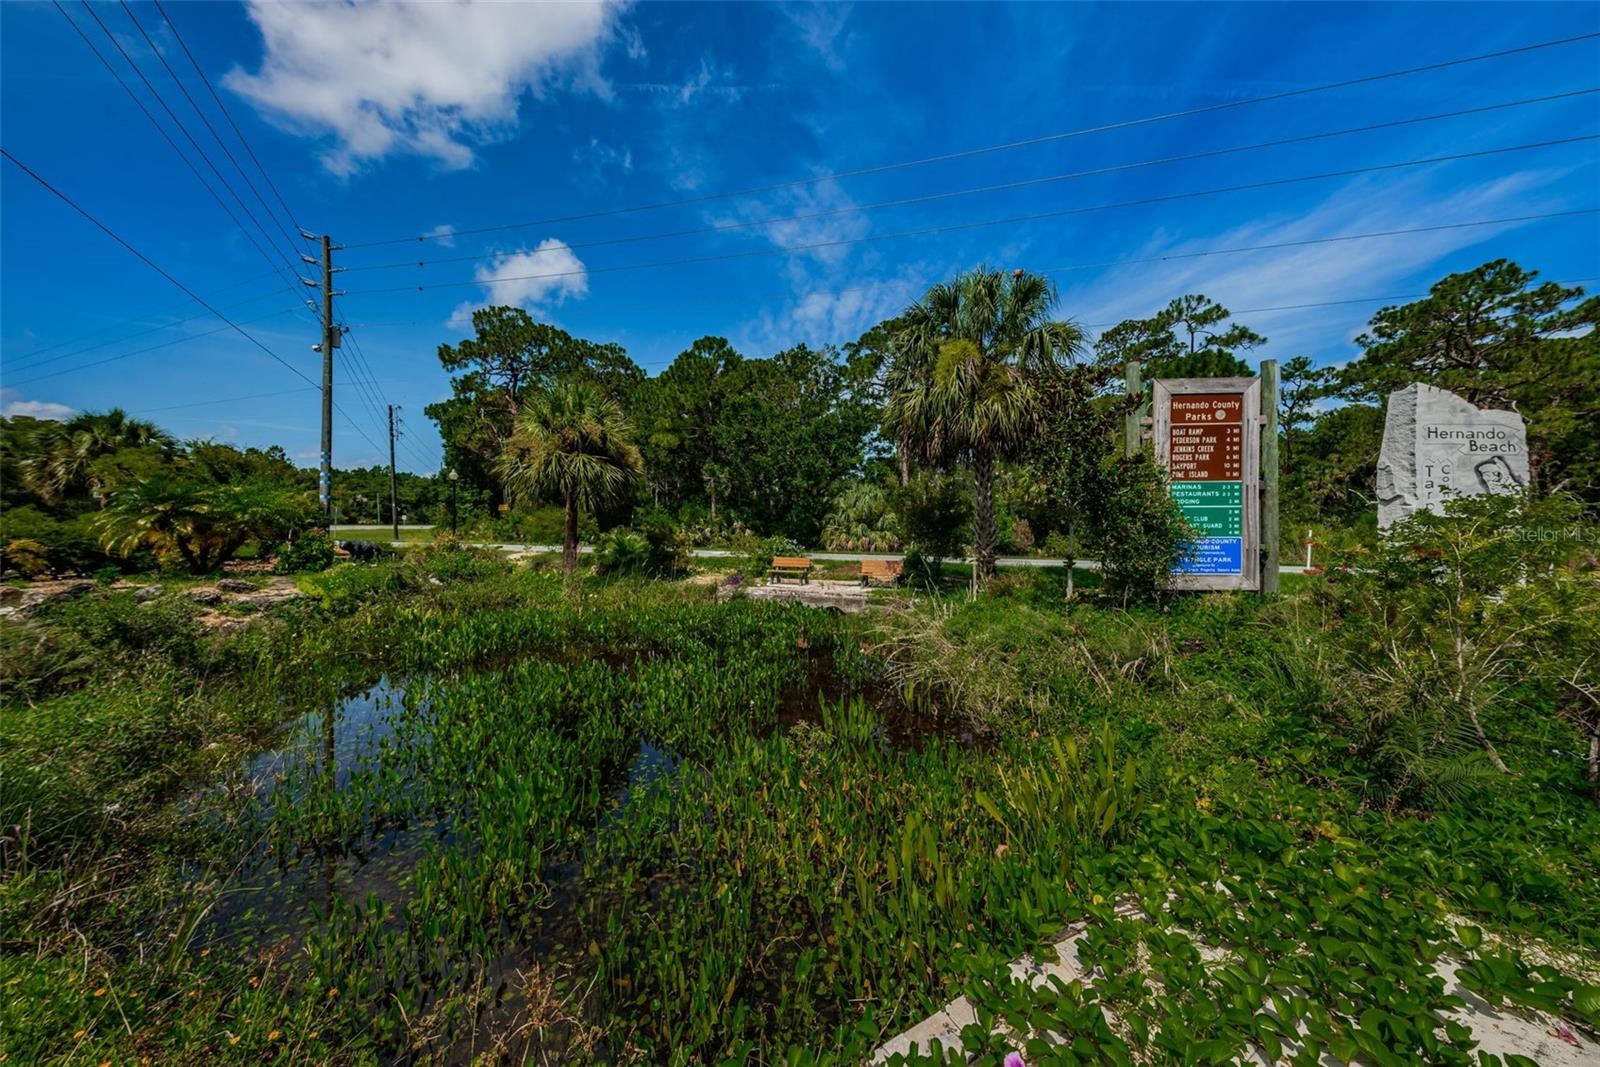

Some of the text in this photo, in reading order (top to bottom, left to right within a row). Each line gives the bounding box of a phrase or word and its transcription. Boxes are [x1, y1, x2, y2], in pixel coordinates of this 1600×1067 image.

[1172, 401, 1240, 410] Hernando County
[1185, 413, 1212, 421] Parks
[1172, 428, 1186, 436] BOAT
[1427, 426, 1506, 439] Hernando
[1469, 440, 1516, 452] Beach
